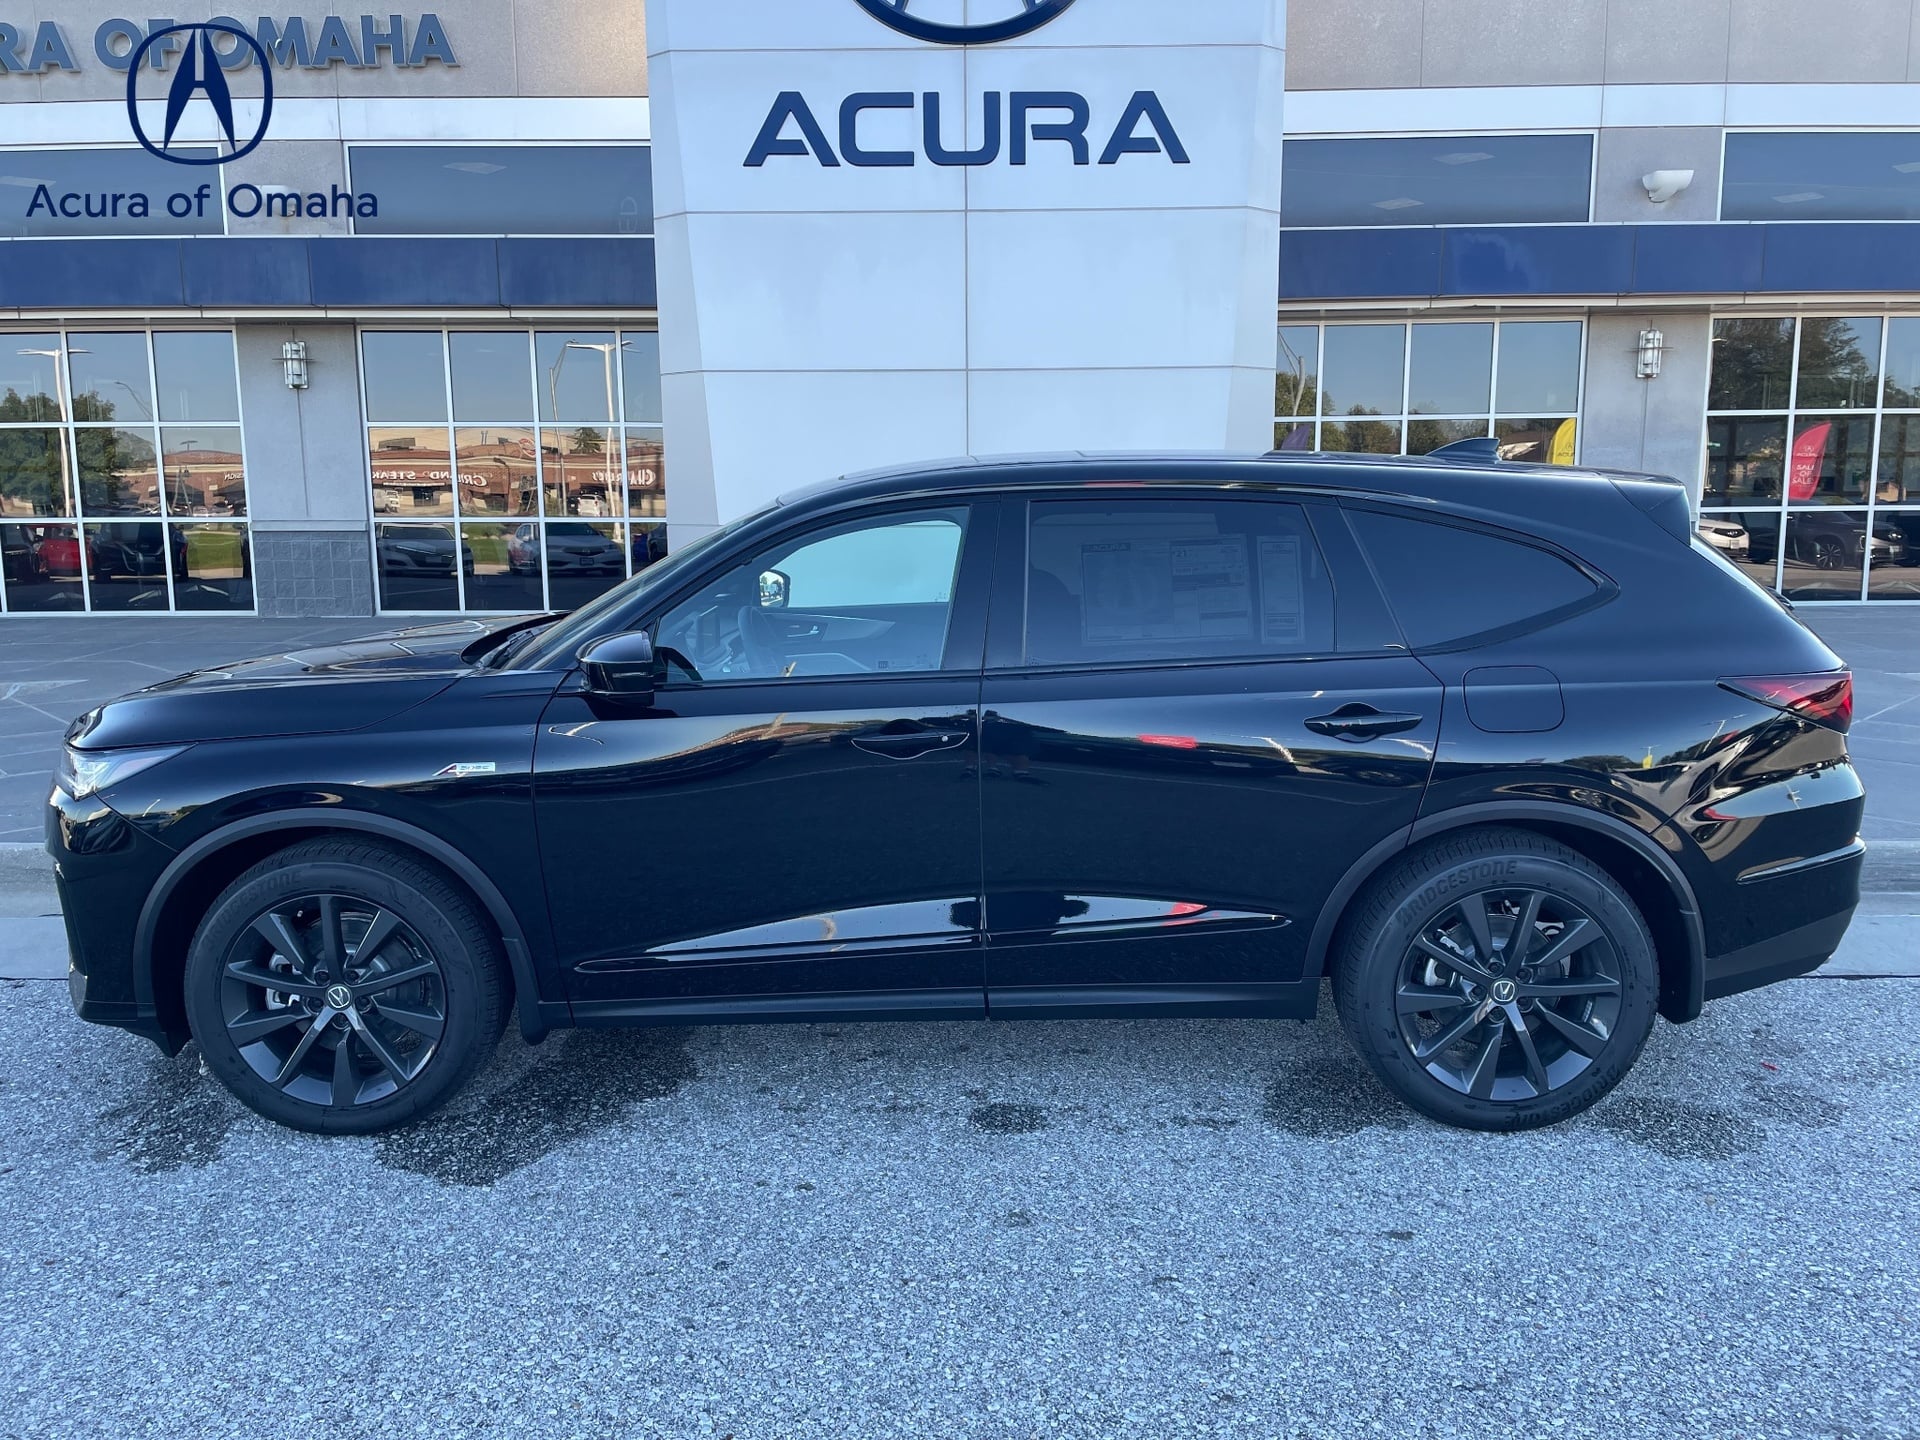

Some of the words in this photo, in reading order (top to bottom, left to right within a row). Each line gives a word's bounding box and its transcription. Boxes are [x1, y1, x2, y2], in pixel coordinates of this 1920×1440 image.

[94, 18, 184, 71] OF
[200, 13, 460, 69] OMAHA
[743, 90, 1191, 167] ACURA
[1396, 860, 1518, 927] BRIDGESTONE
